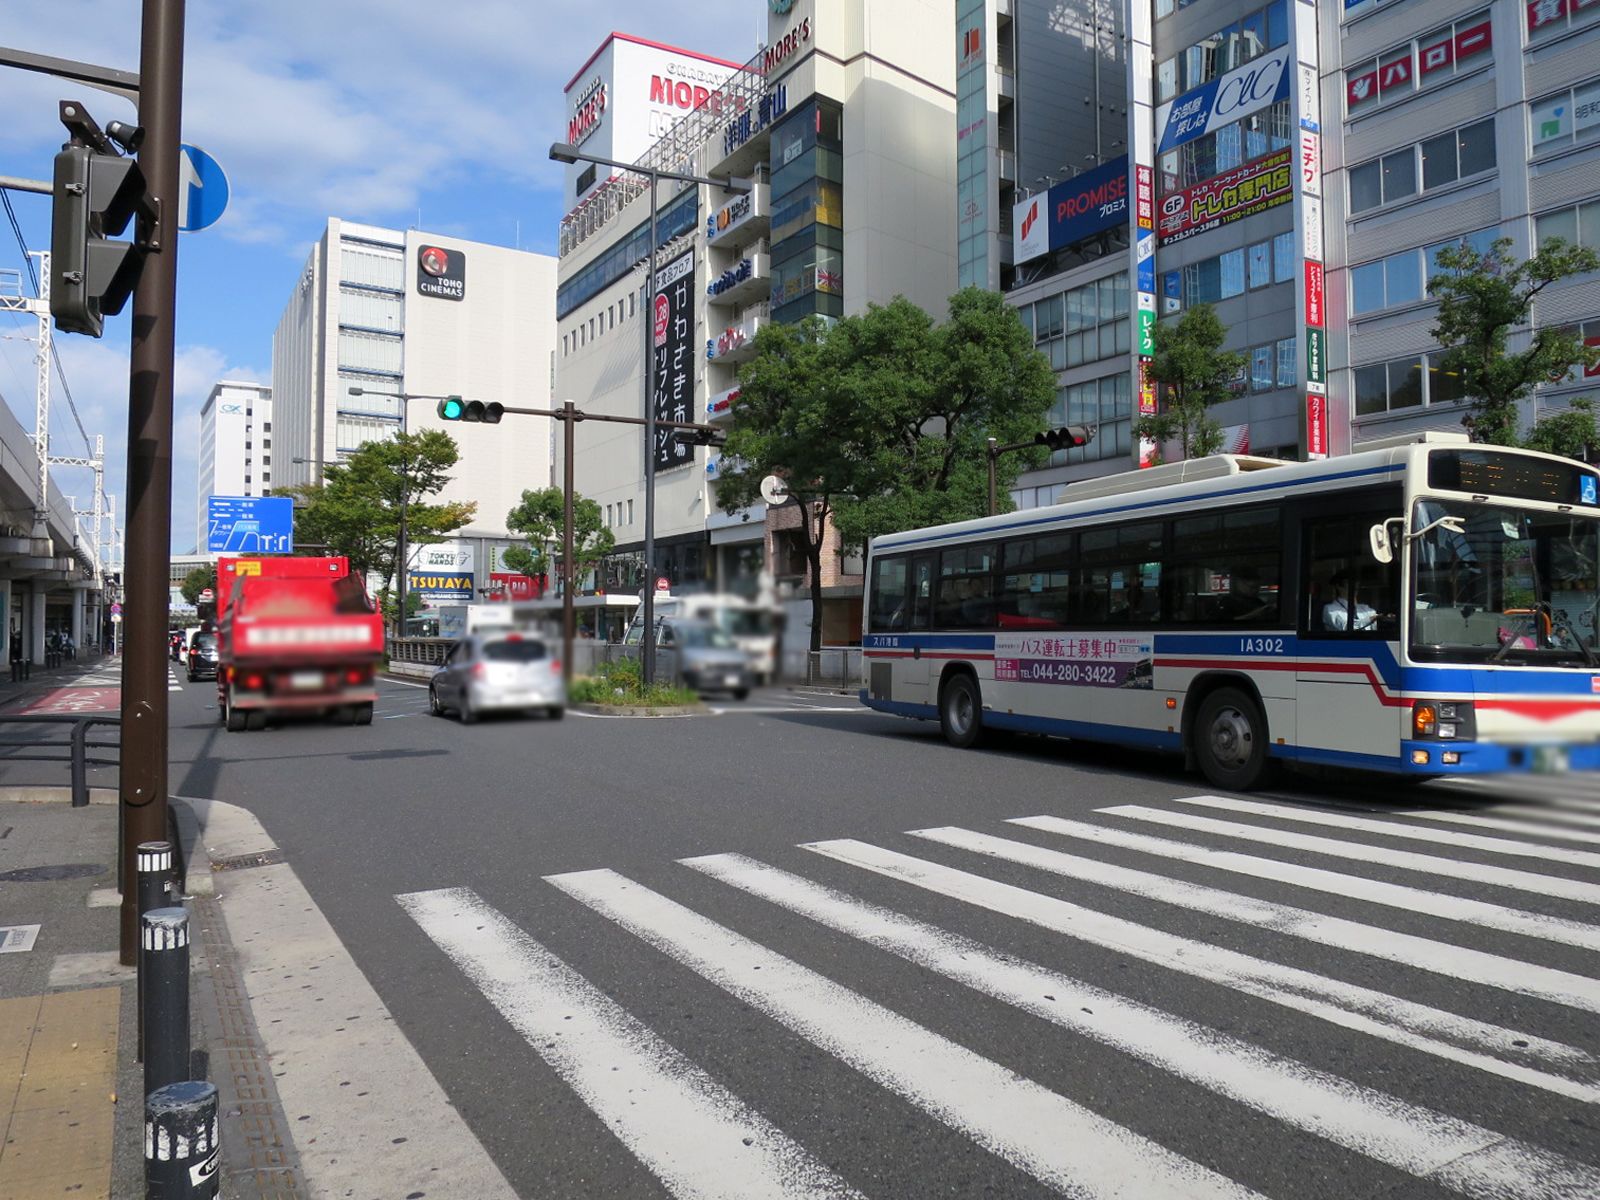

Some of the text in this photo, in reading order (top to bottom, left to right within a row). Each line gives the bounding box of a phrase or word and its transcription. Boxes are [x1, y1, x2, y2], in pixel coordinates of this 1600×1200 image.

[764, 16, 811, 73] MORE'S
[1384, 32, 1486, 87] ハロー
[723, 82, 787, 156] 洋服の青山
[1303, 138, 1314, 183] ニチワ
[1056, 176, 1127, 223] PROMISE
[1192, 166, 1291, 223] トレカ専門店
[1099, 198, 1126, 218] プロミス
[1165, 198, 1181, 213] 6F
[420, 282, 462, 297] CINEMAS
[437, 277, 462, 289] TOHO
[1142, 314, 1152, 350] レイク
[430, 552, 456, 560] TOKYU
[411, 576, 473, 590] TSUTAYA
[1020, 638, 1117, 659] バス運転士募集中
[1033, 663, 1117, 684] 044-280-3422
